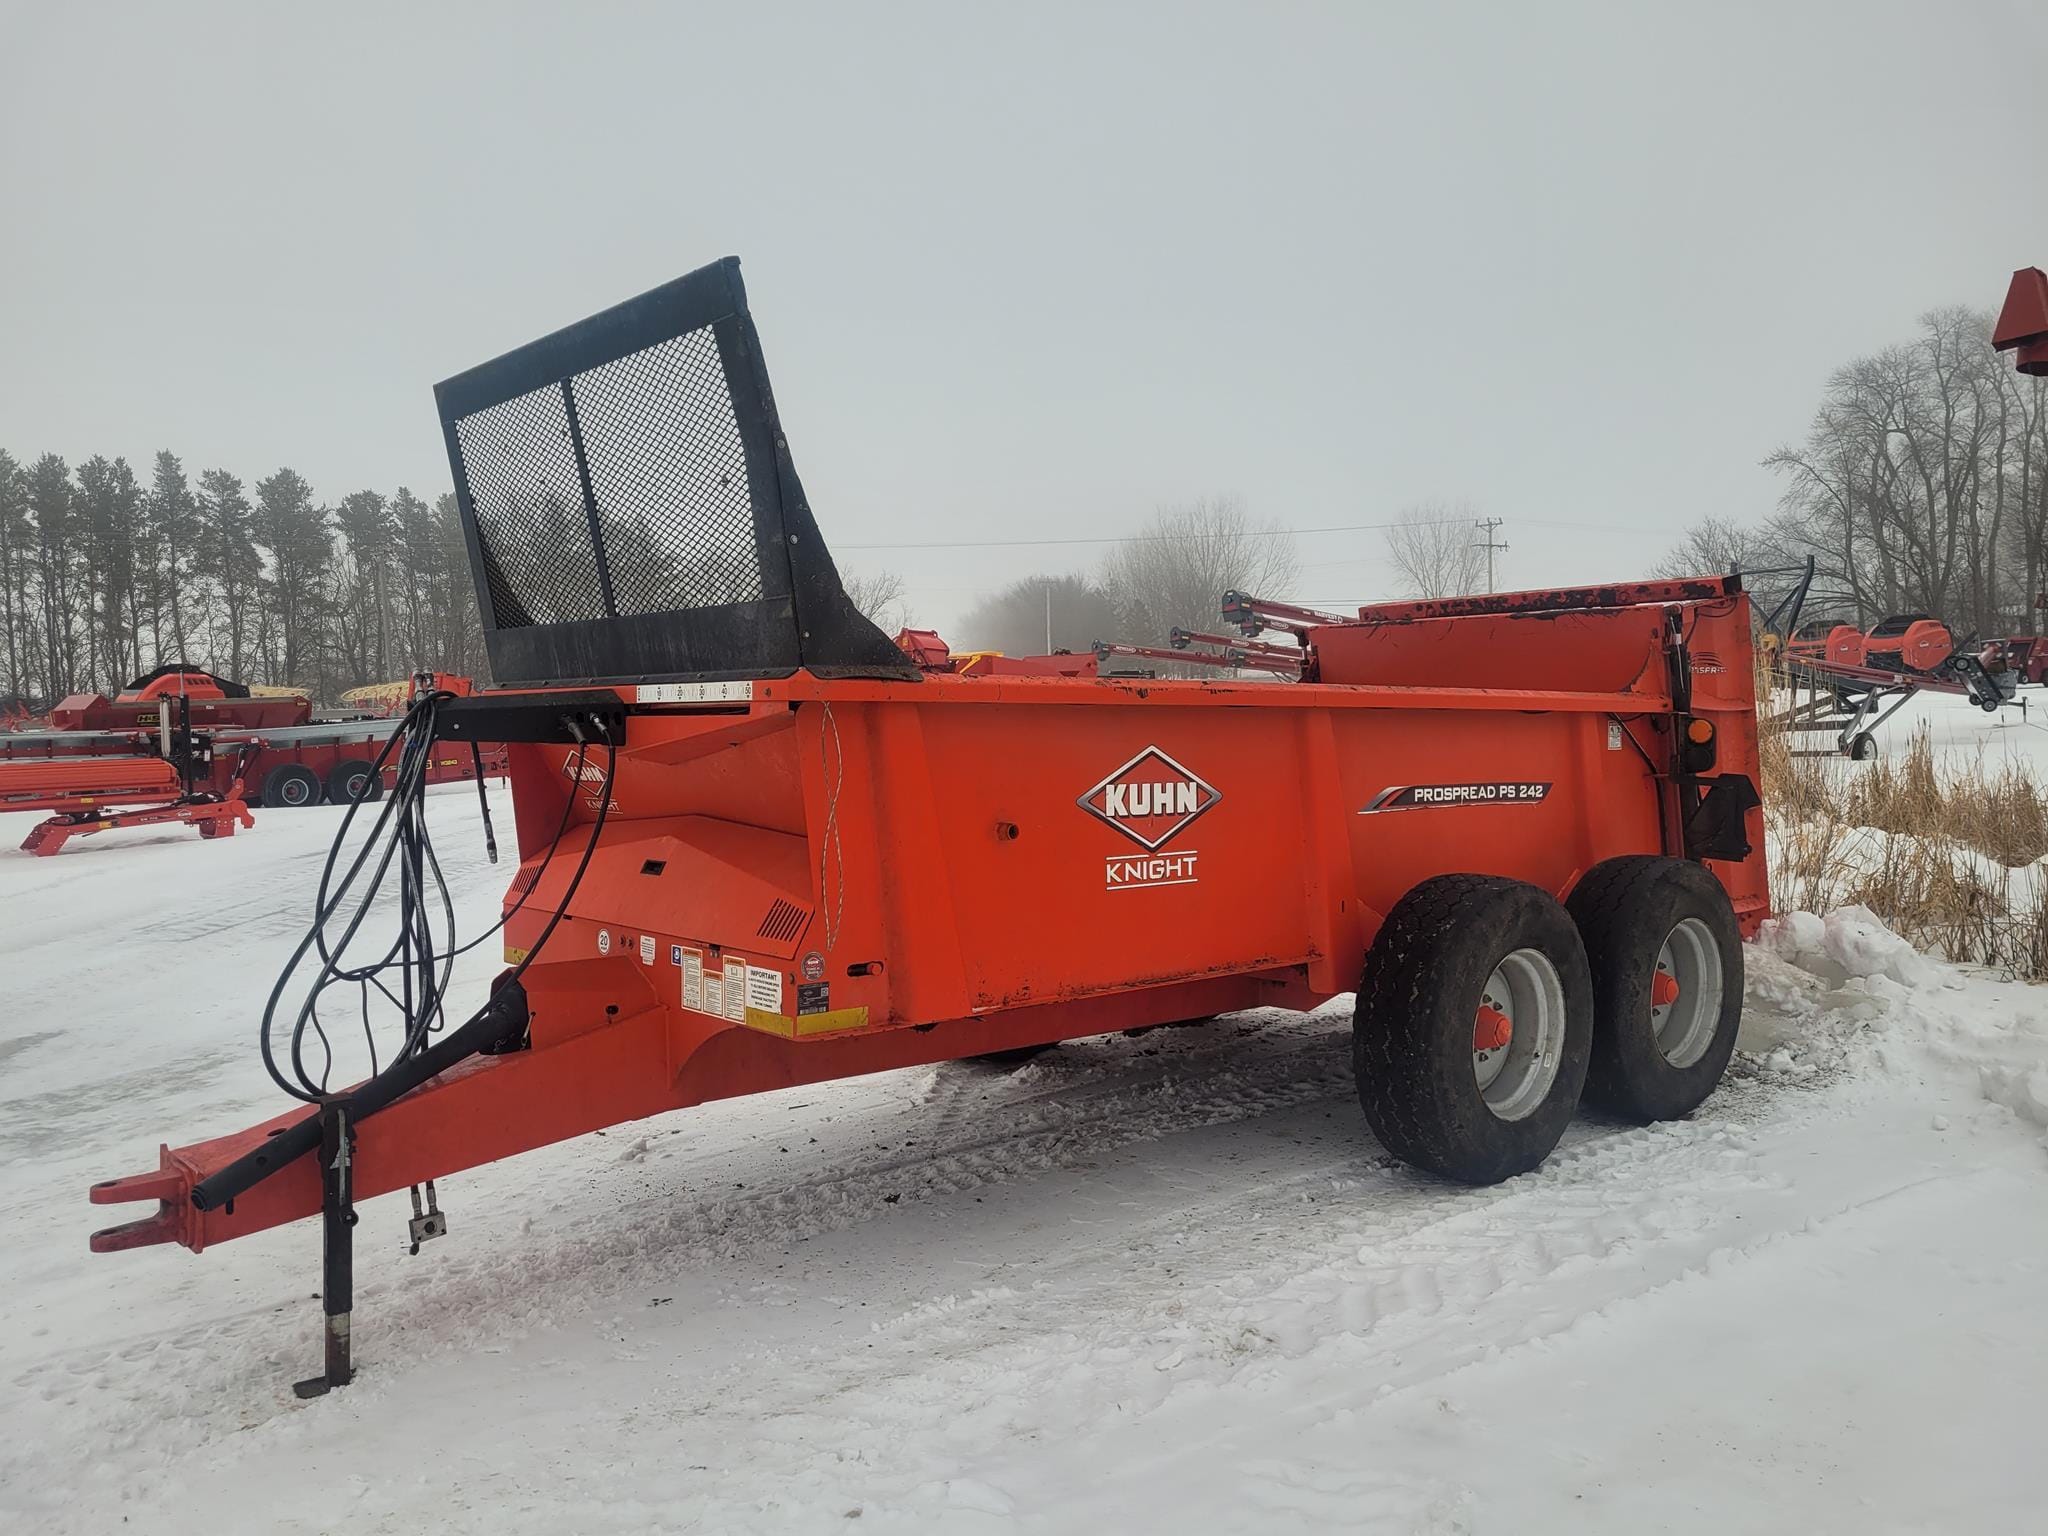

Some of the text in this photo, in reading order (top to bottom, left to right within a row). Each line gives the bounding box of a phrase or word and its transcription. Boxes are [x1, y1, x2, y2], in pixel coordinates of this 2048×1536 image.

[699, 688, 705, 696] 30
[721, 687, 728, 695] 40
[745, 687, 751, 695] 50
[1105, 781, 1197, 817] KUHN
[1414, 784, 1543, 802] PROSPREAD PS 242
[1106, 857, 1198, 883] KNIGHT
[600, 934, 608, 946] 20
[750, 969, 777, 981] IMPORTANT
